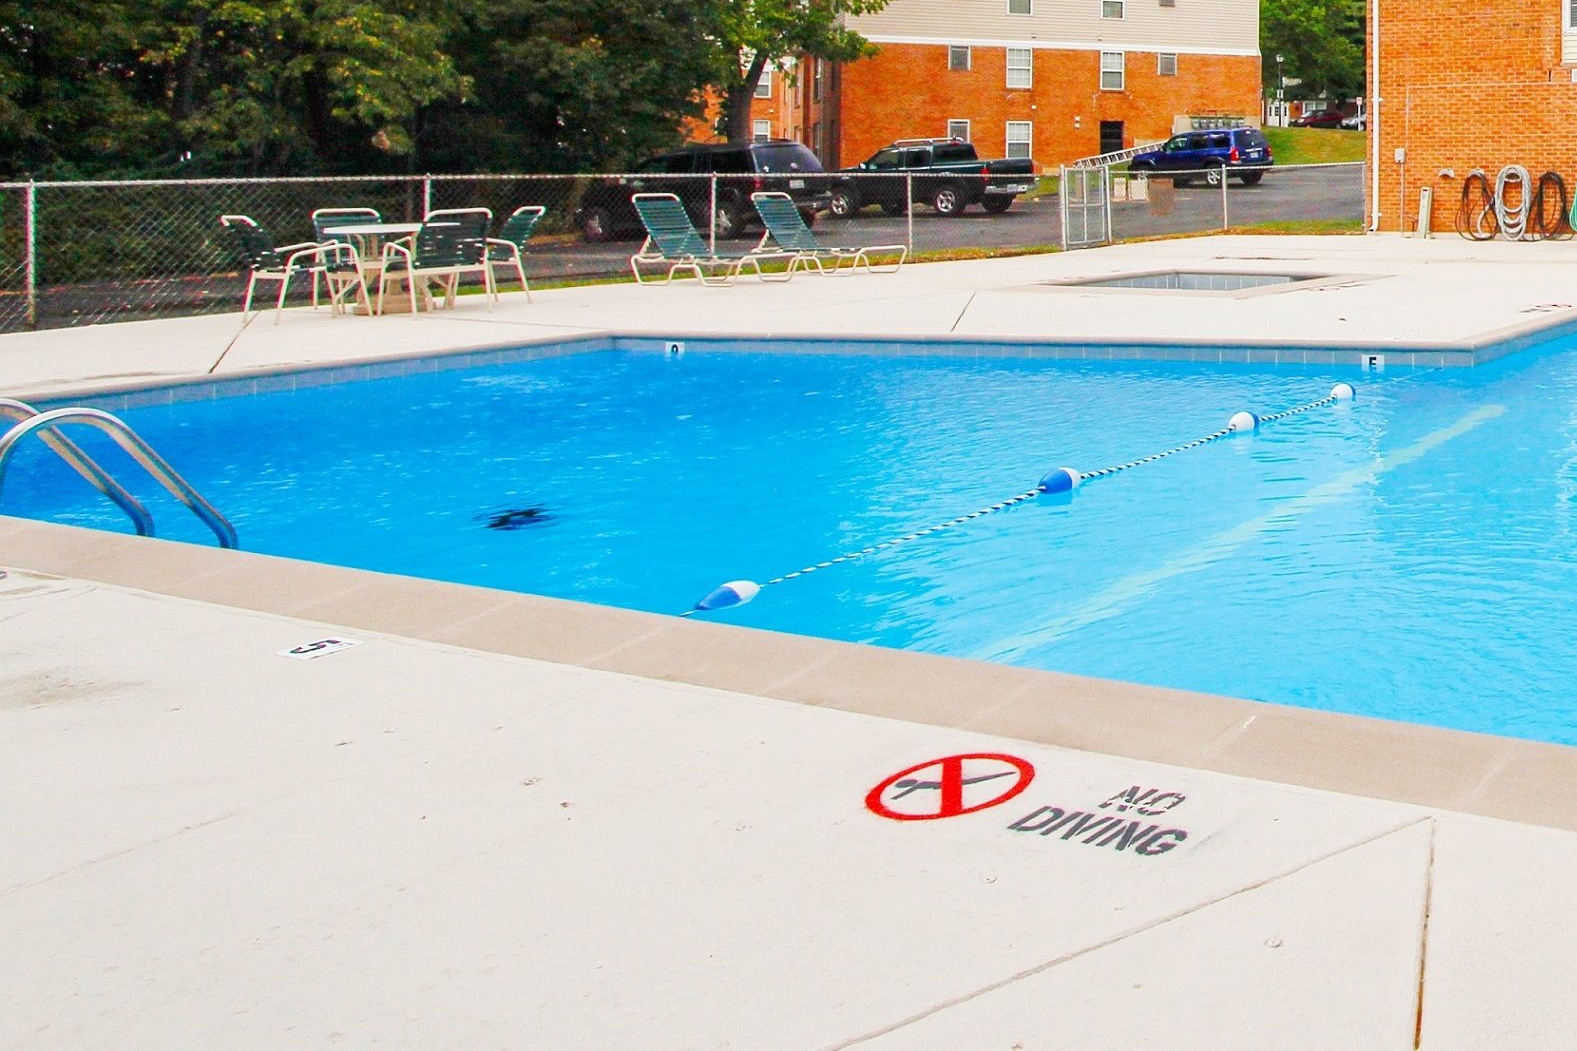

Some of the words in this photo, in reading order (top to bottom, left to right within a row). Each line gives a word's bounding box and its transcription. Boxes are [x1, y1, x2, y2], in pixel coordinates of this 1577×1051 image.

[289, 639, 342, 654] 5
[1098, 785, 1186, 816] NO
[1006, 806, 1188, 856] DIVING
